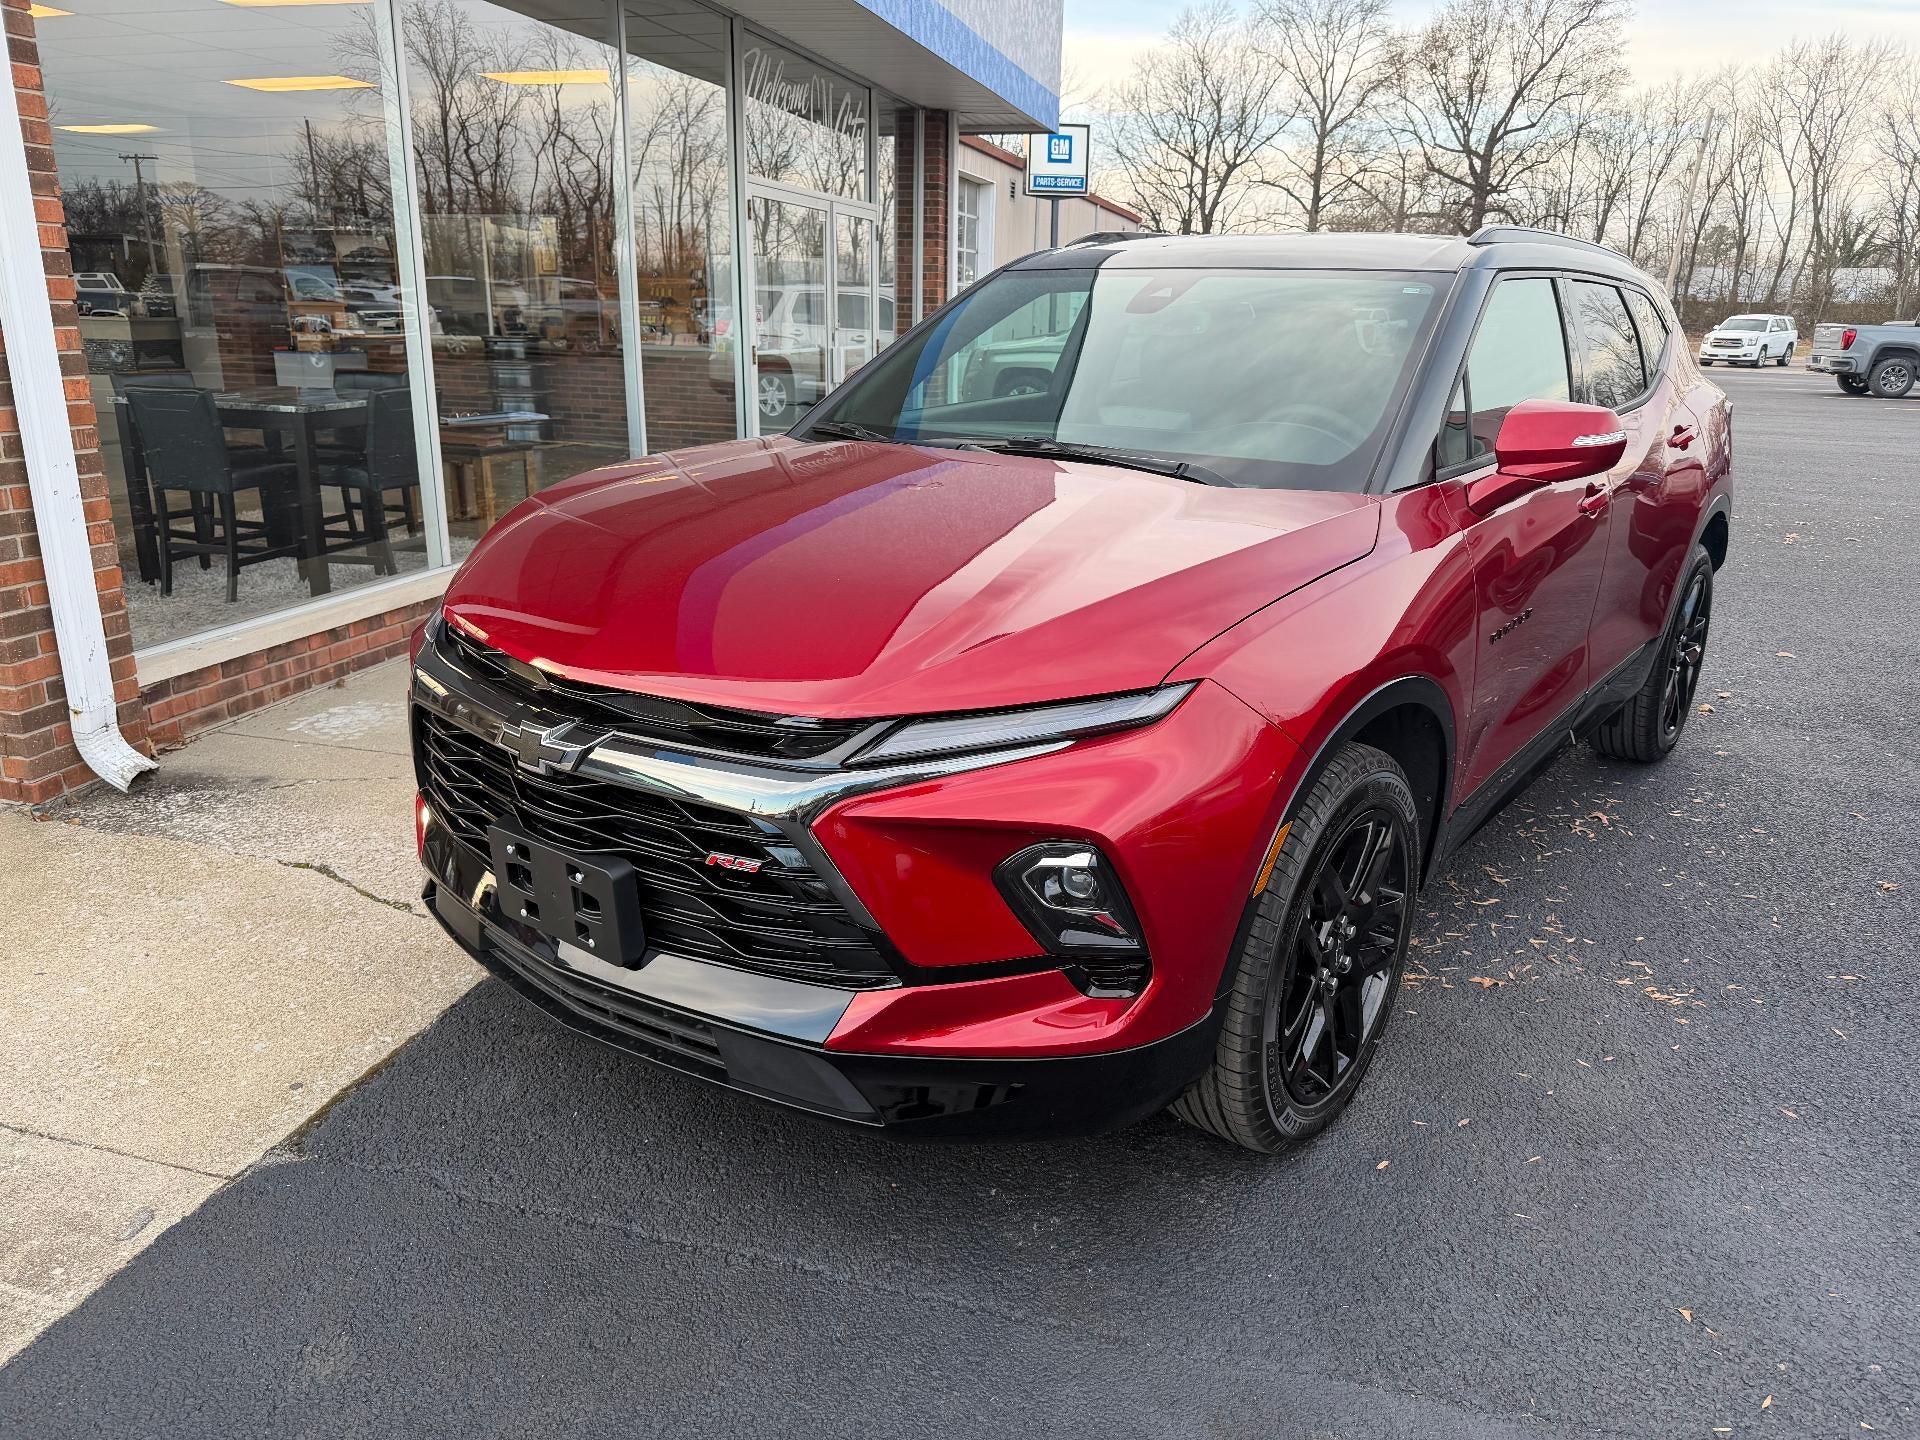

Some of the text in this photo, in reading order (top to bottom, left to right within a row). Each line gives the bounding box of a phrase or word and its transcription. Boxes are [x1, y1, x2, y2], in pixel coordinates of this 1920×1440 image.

[743, 47, 810, 115] Welcome
[1051, 138, 1070, 155] GM
[705, 852, 761, 872] RS
